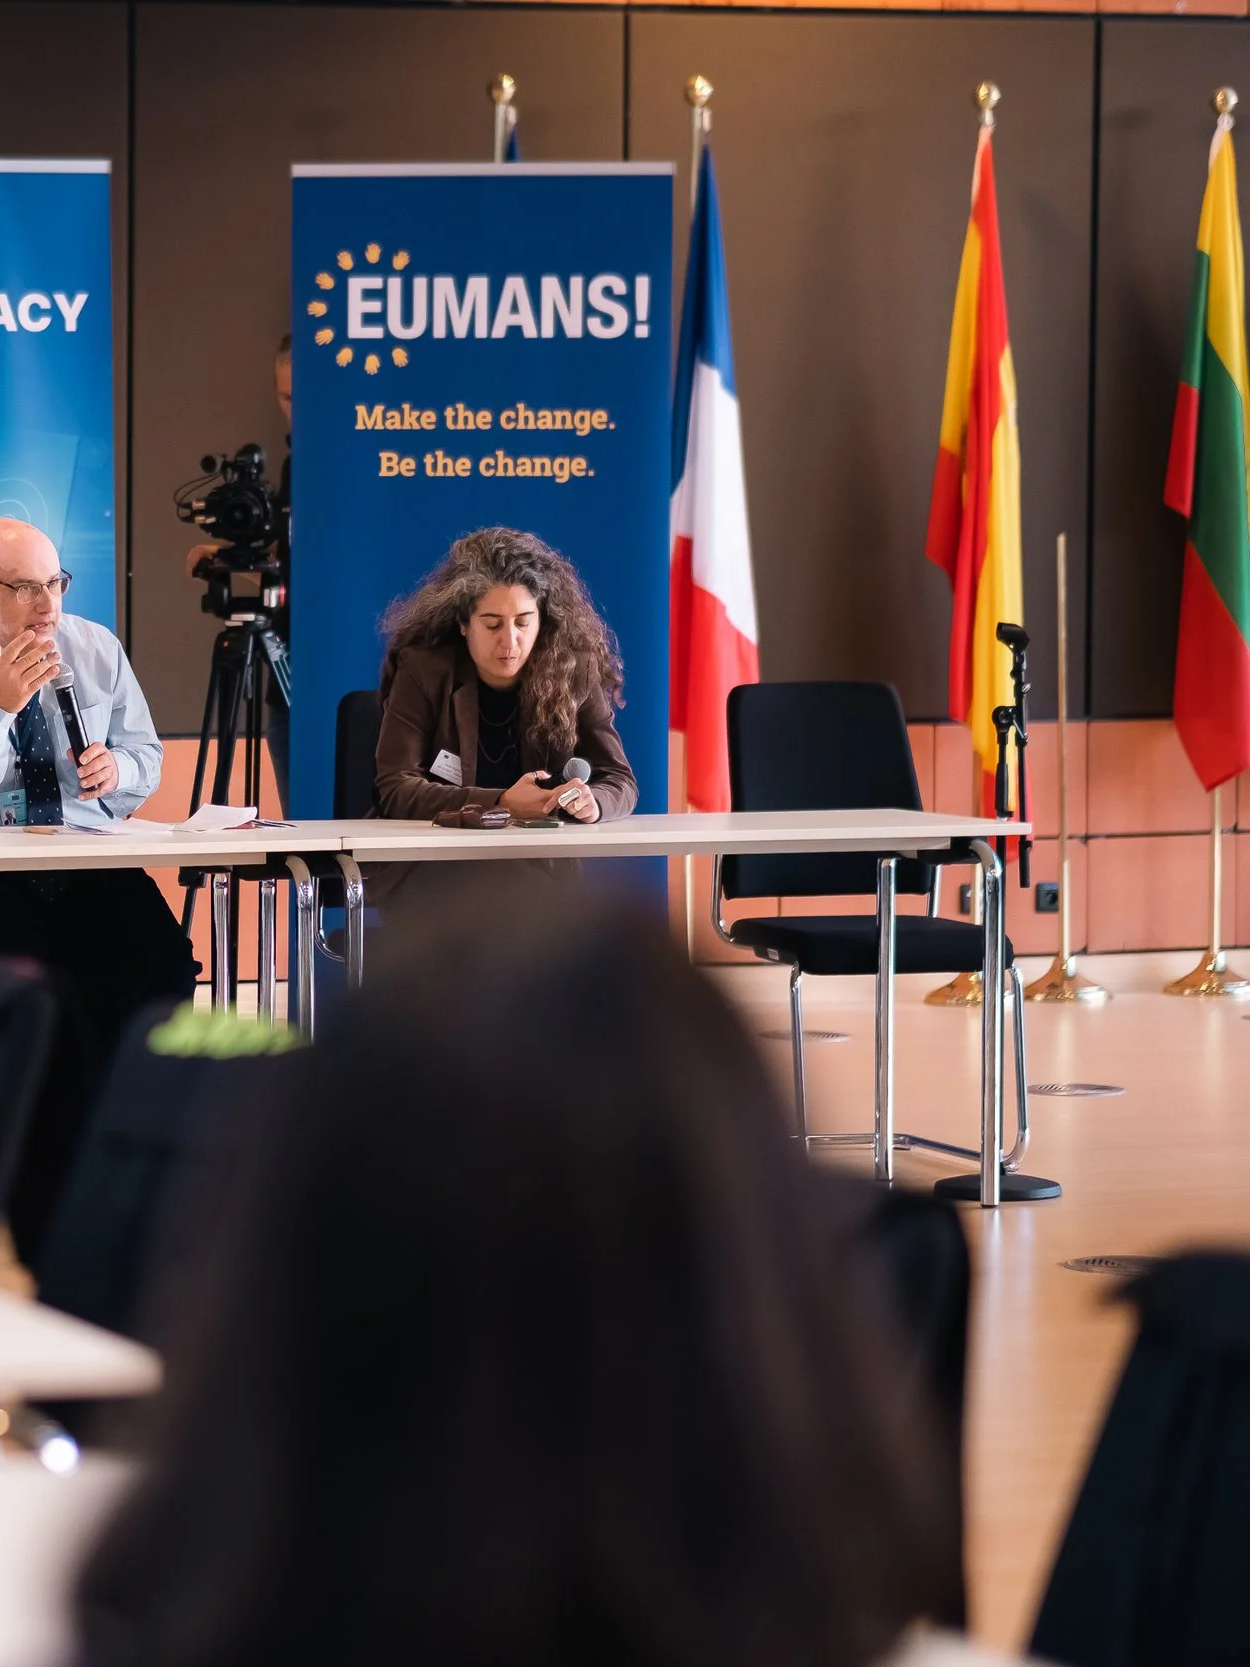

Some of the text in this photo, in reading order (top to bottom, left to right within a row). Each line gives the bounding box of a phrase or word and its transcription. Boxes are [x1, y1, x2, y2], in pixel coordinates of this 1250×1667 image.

[347, 274, 650, 339] EUMANS!
[355, 403, 617, 437] Make the change.
[378, 450, 596, 483] Be the change.
